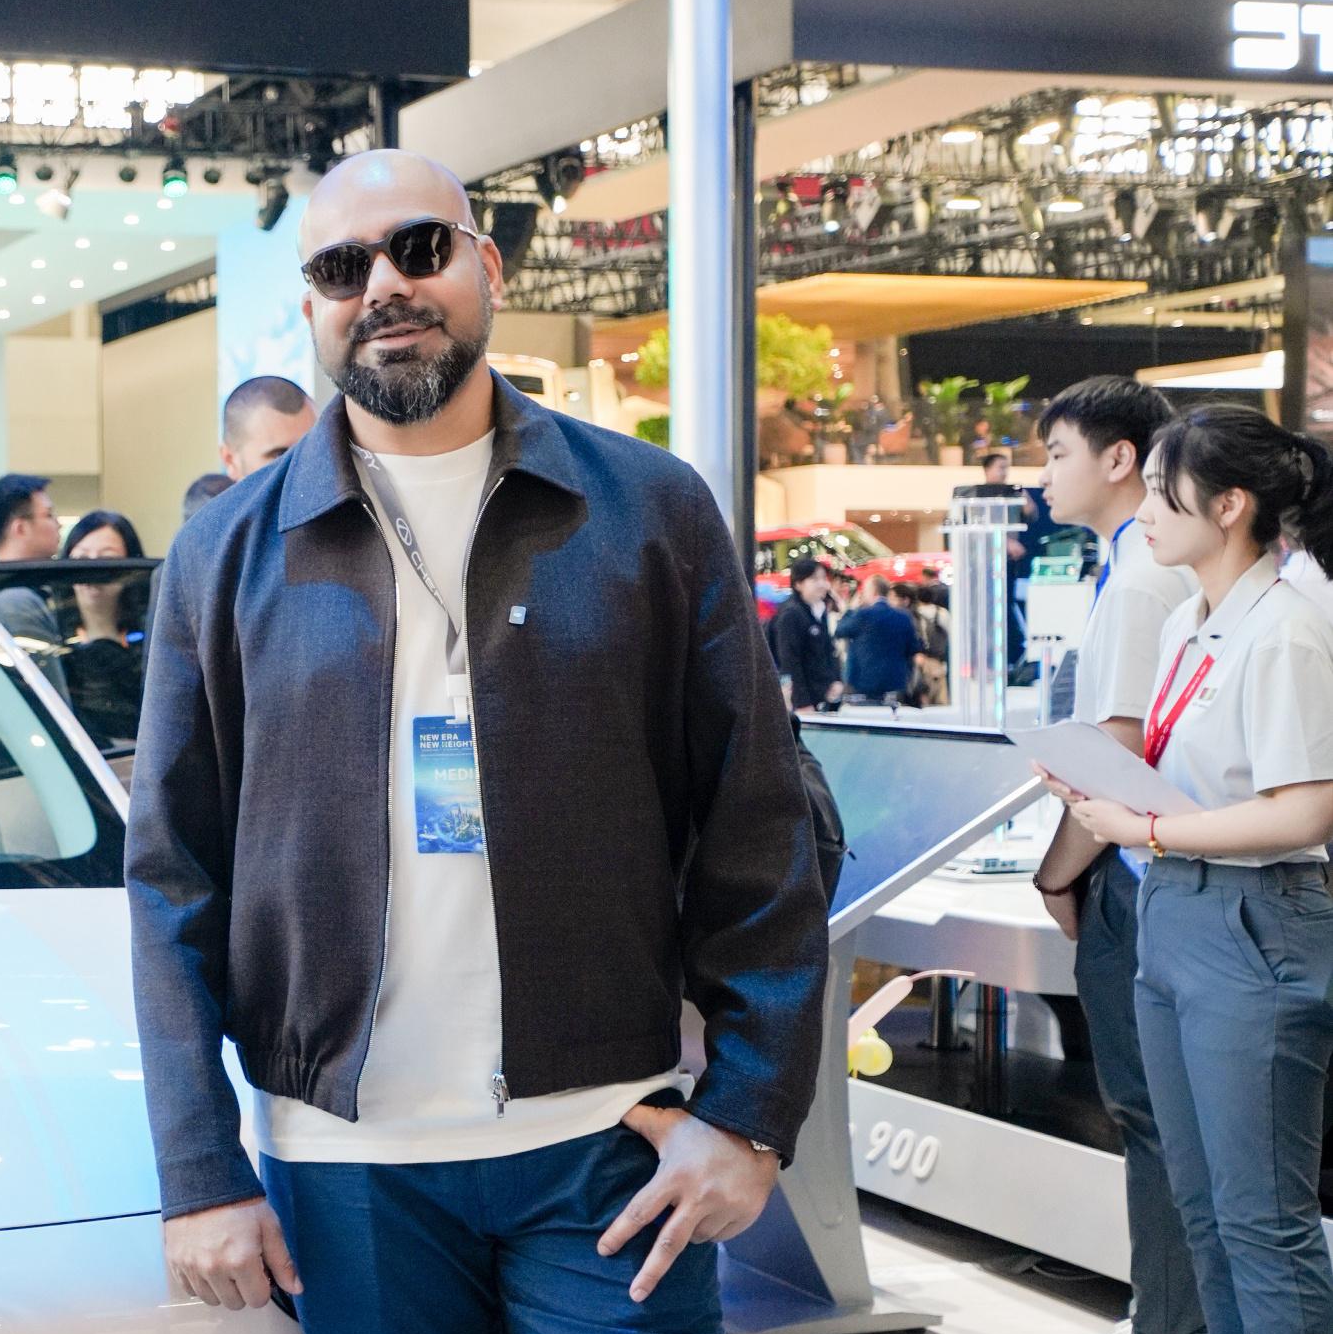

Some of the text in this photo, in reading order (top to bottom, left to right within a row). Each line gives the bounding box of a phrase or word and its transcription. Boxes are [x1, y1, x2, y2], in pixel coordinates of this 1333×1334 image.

[419, 733, 458, 742] NEW ERA
[865, 1121, 941, 1179] 900
